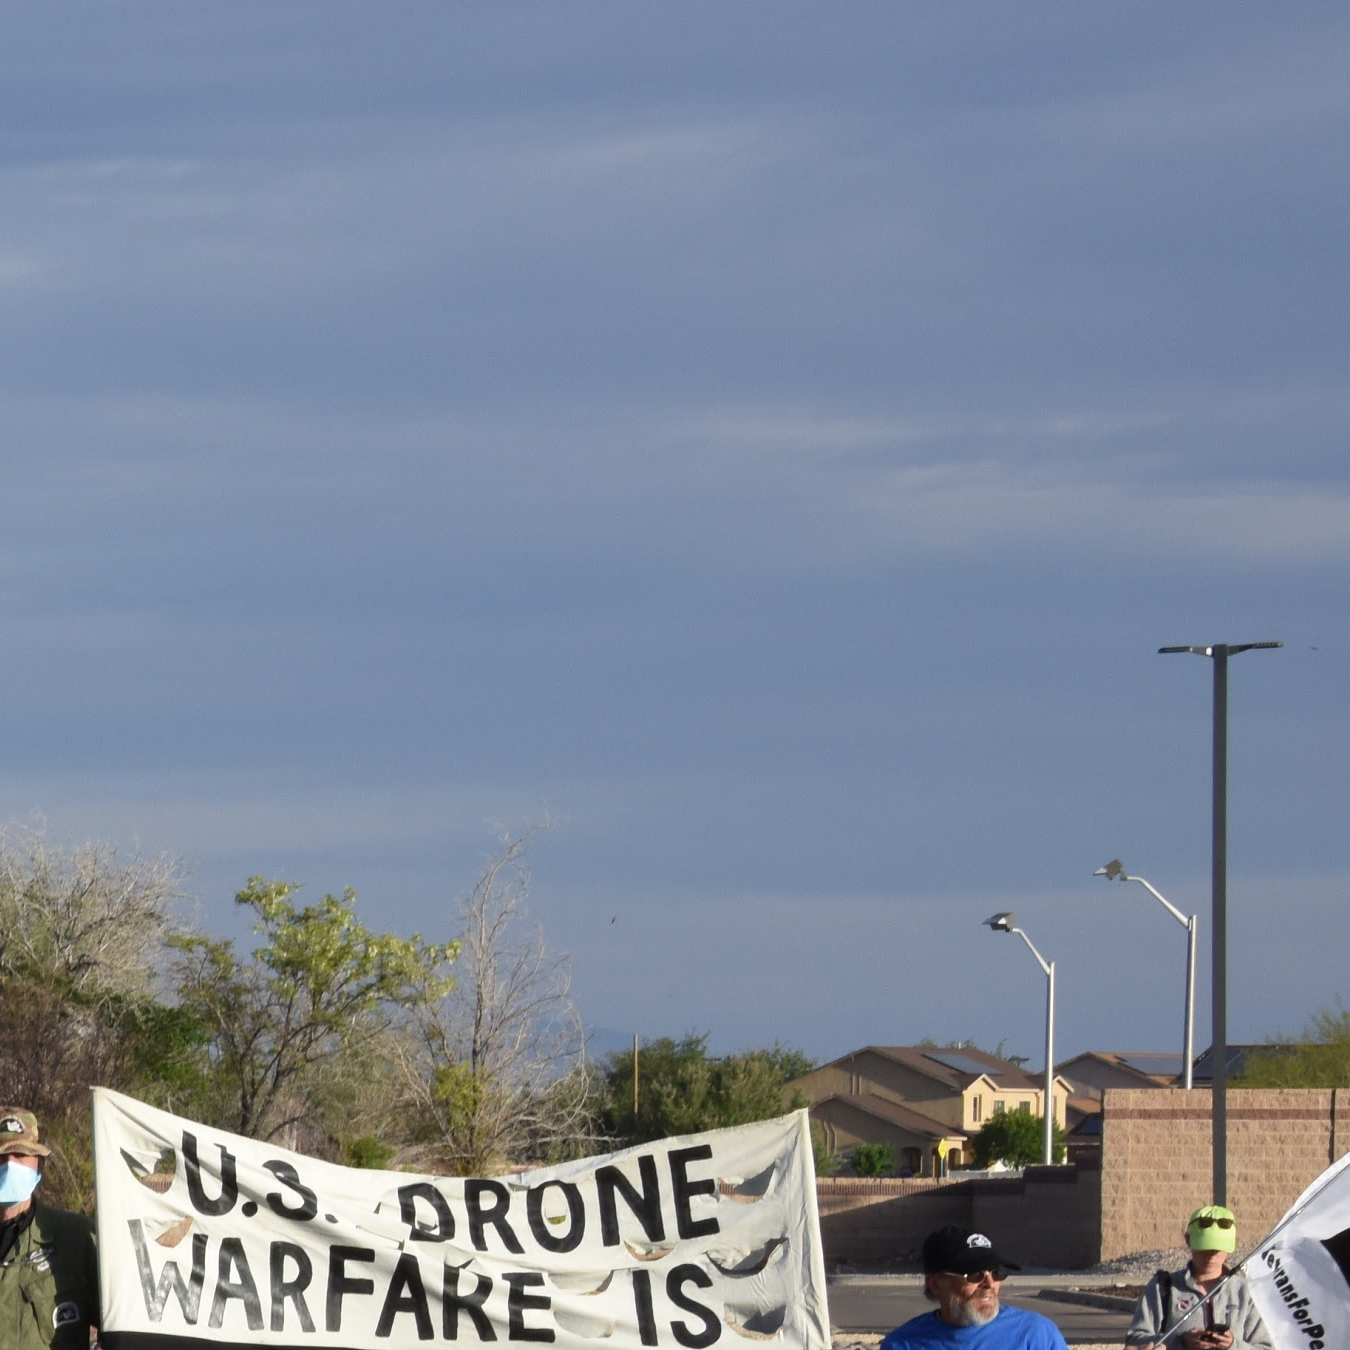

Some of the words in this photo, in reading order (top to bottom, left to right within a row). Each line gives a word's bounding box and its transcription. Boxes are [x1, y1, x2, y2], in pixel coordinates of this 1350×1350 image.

[181, 1130, 338, 1224] U.S.
[398, 1144, 722, 1254] DRONE
[128, 1219, 556, 1342] WARFARE
[633, 1262, 722, 1349] IS
